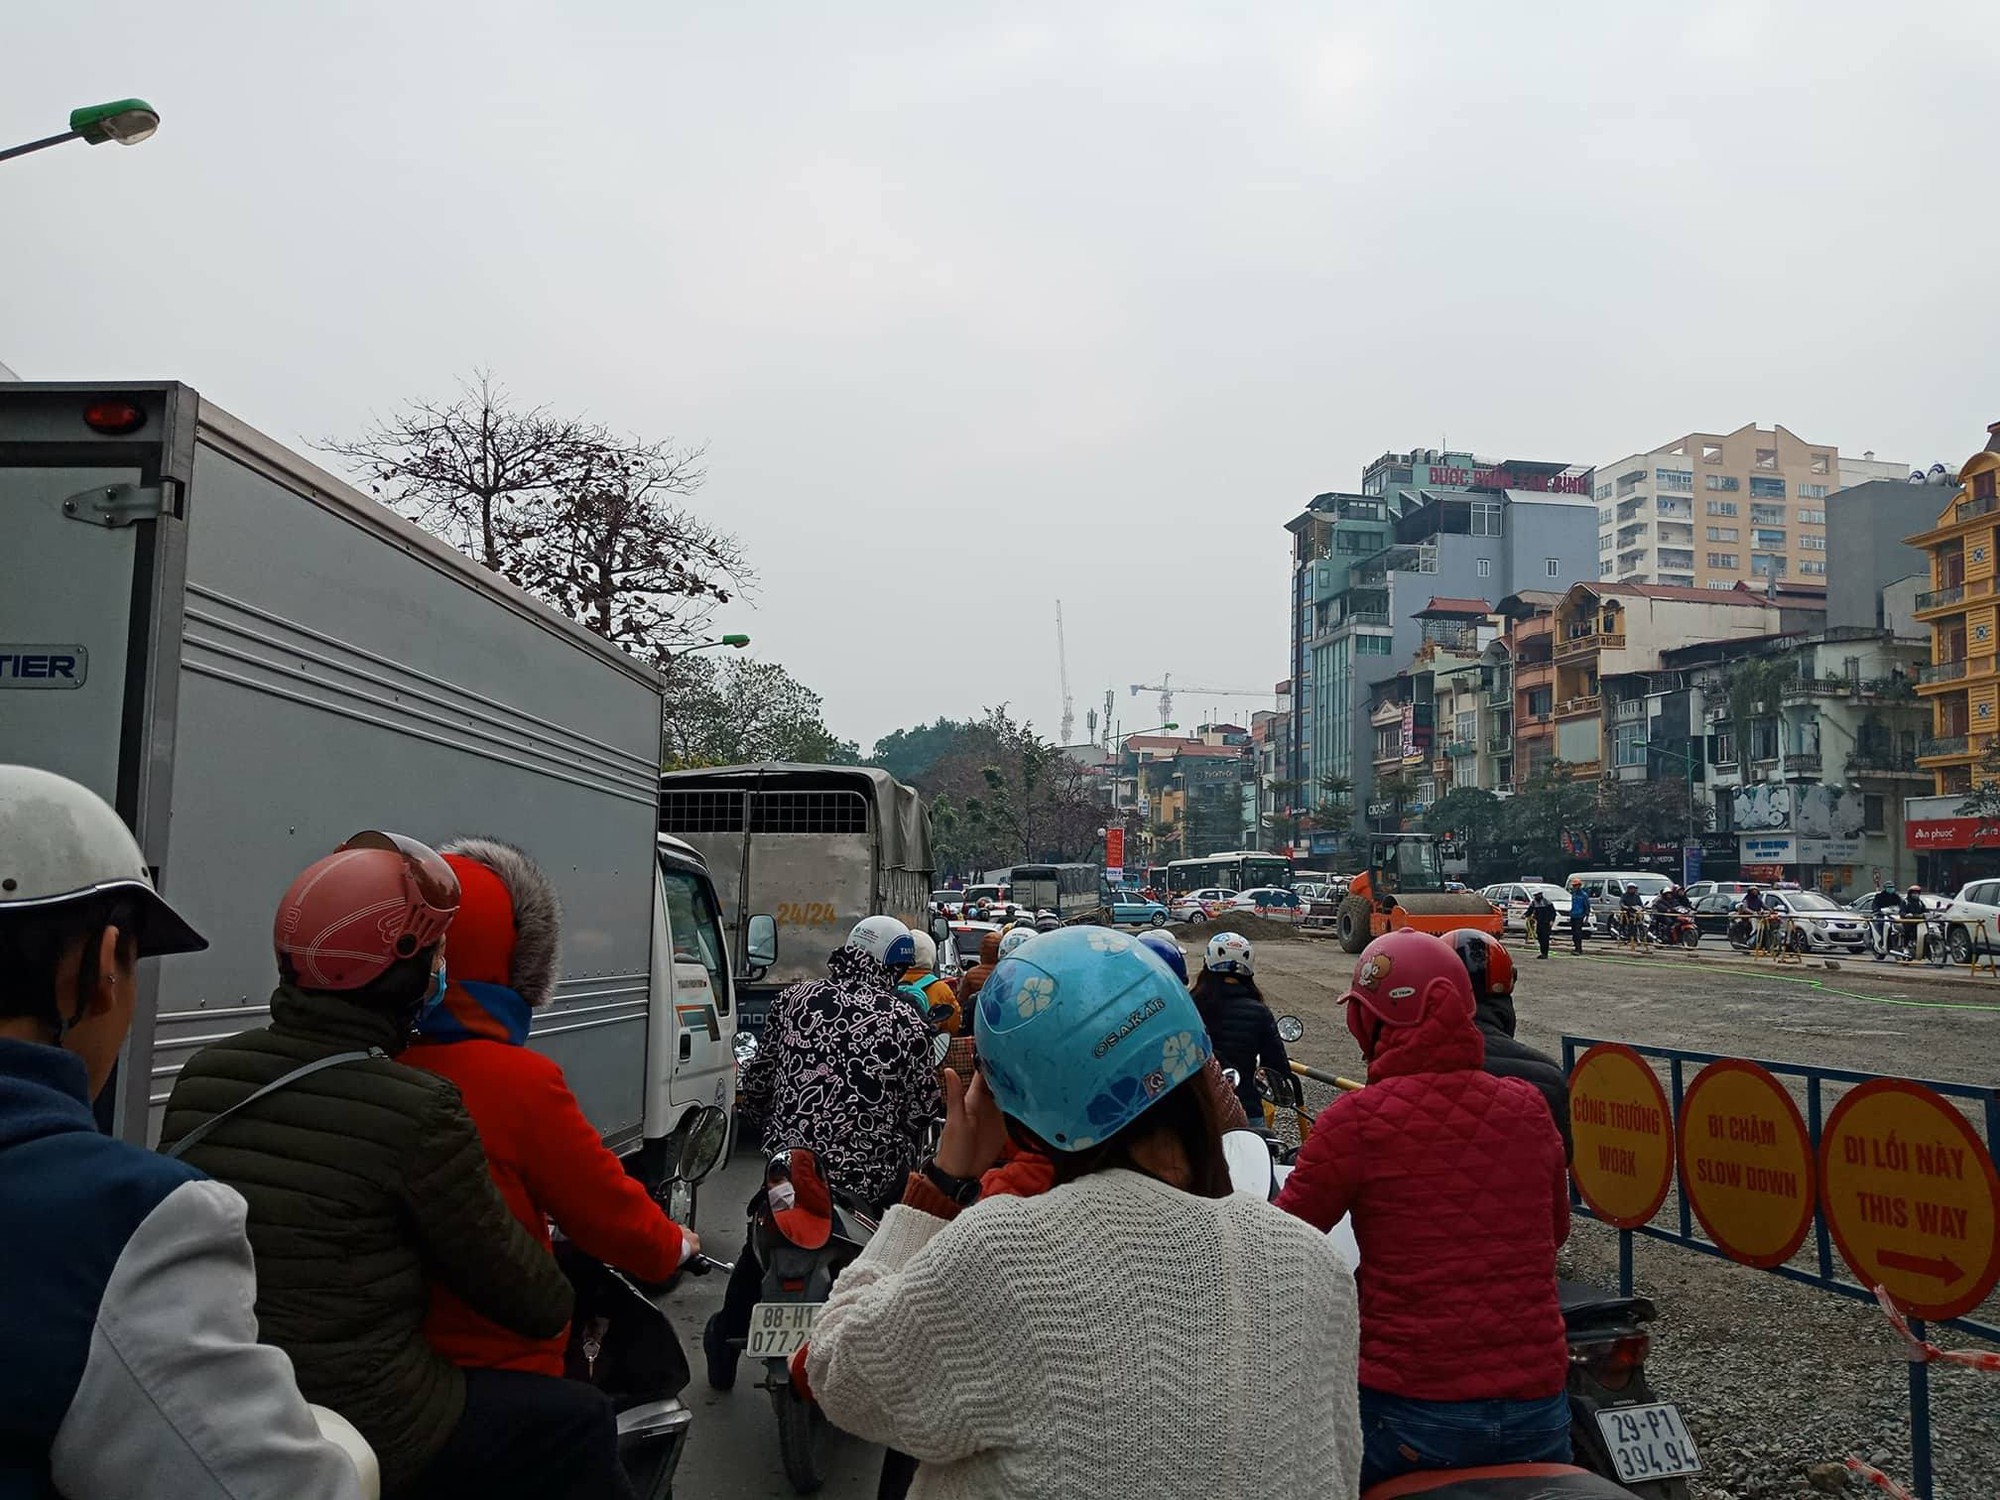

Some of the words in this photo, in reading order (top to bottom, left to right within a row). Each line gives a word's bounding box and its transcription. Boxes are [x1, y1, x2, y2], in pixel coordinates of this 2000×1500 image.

[778, 902, 838, 926] 24/24
[1574, 1093, 1606, 1125] CÔNG
[1609, 1099, 1660, 1135] TRƯỜNG
[1729, 1114, 1776, 1147] CHẬM
[1598, 1144, 1636, 1178] WORK
[1697, 1157, 1740, 1188] SLOW
[1746, 1166, 1797, 1199] DOWN
[1915, 1140, 1964, 1181] NÀY
[1857, 1191, 1908, 1229] THIS
[1915, 1201, 1968, 1240] WAY
[752, 1331, 811, 1352] 077.2
[1611, 1409, 1676, 1443] 29-P1
[1617, 1440, 1697, 1477] 394.94
